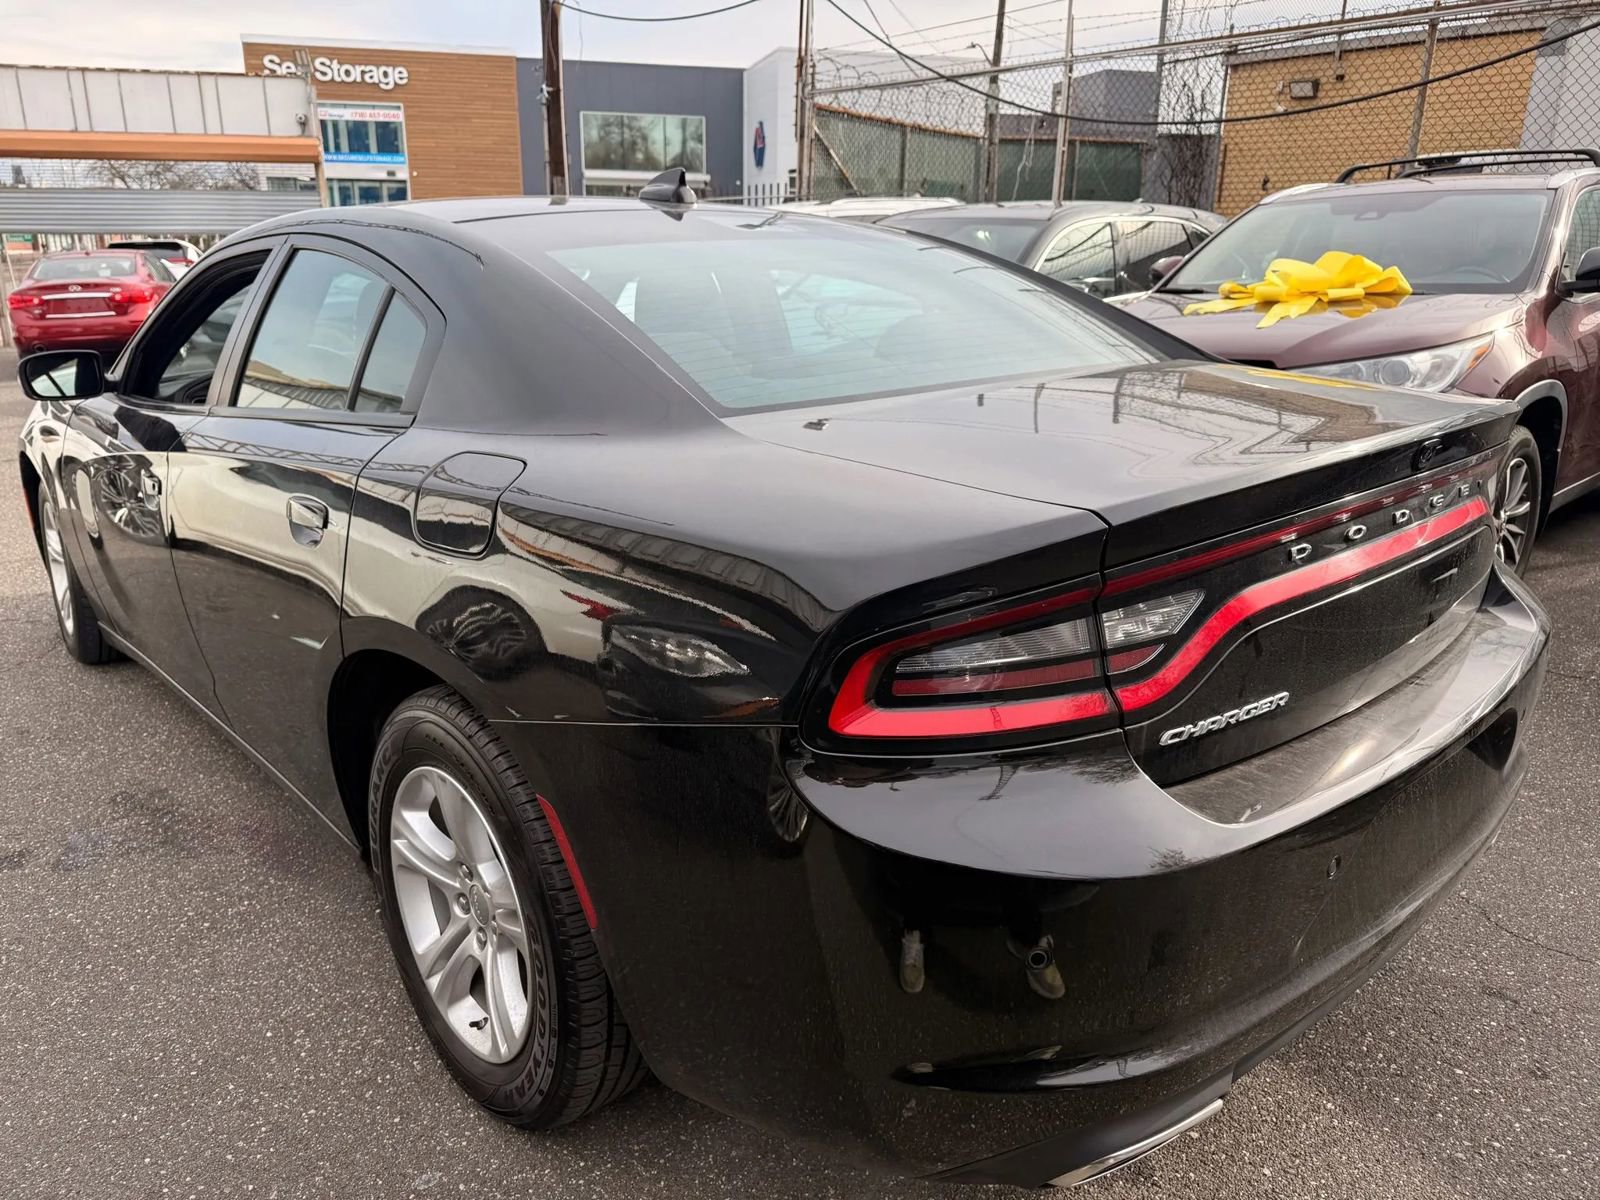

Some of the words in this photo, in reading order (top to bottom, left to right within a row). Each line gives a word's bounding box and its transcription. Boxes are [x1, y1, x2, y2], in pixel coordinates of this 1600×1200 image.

[263, 54, 303, 76] Se
[314, 57, 409, 90] Storage
[1289, 483, 1471, 561] DODGE
[1158, 691, 1290, 747] CHARGER
